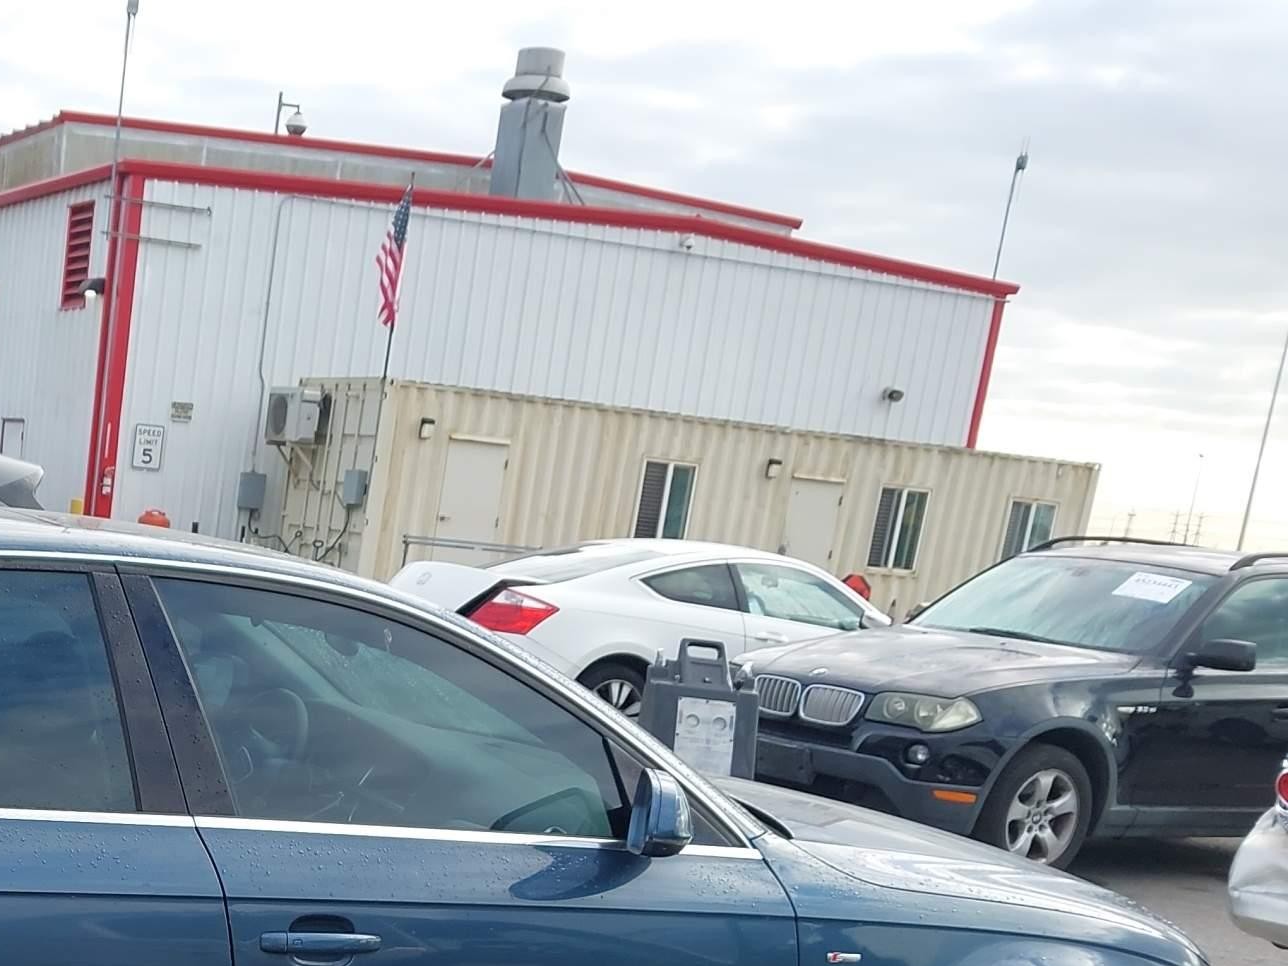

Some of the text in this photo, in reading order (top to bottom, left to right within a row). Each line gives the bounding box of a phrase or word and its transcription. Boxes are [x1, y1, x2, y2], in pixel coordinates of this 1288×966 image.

[138, 428, 162, 437] SPEED
[139, 437, 159, 445] LIMIT
[141, 448, 153, 464] 5
